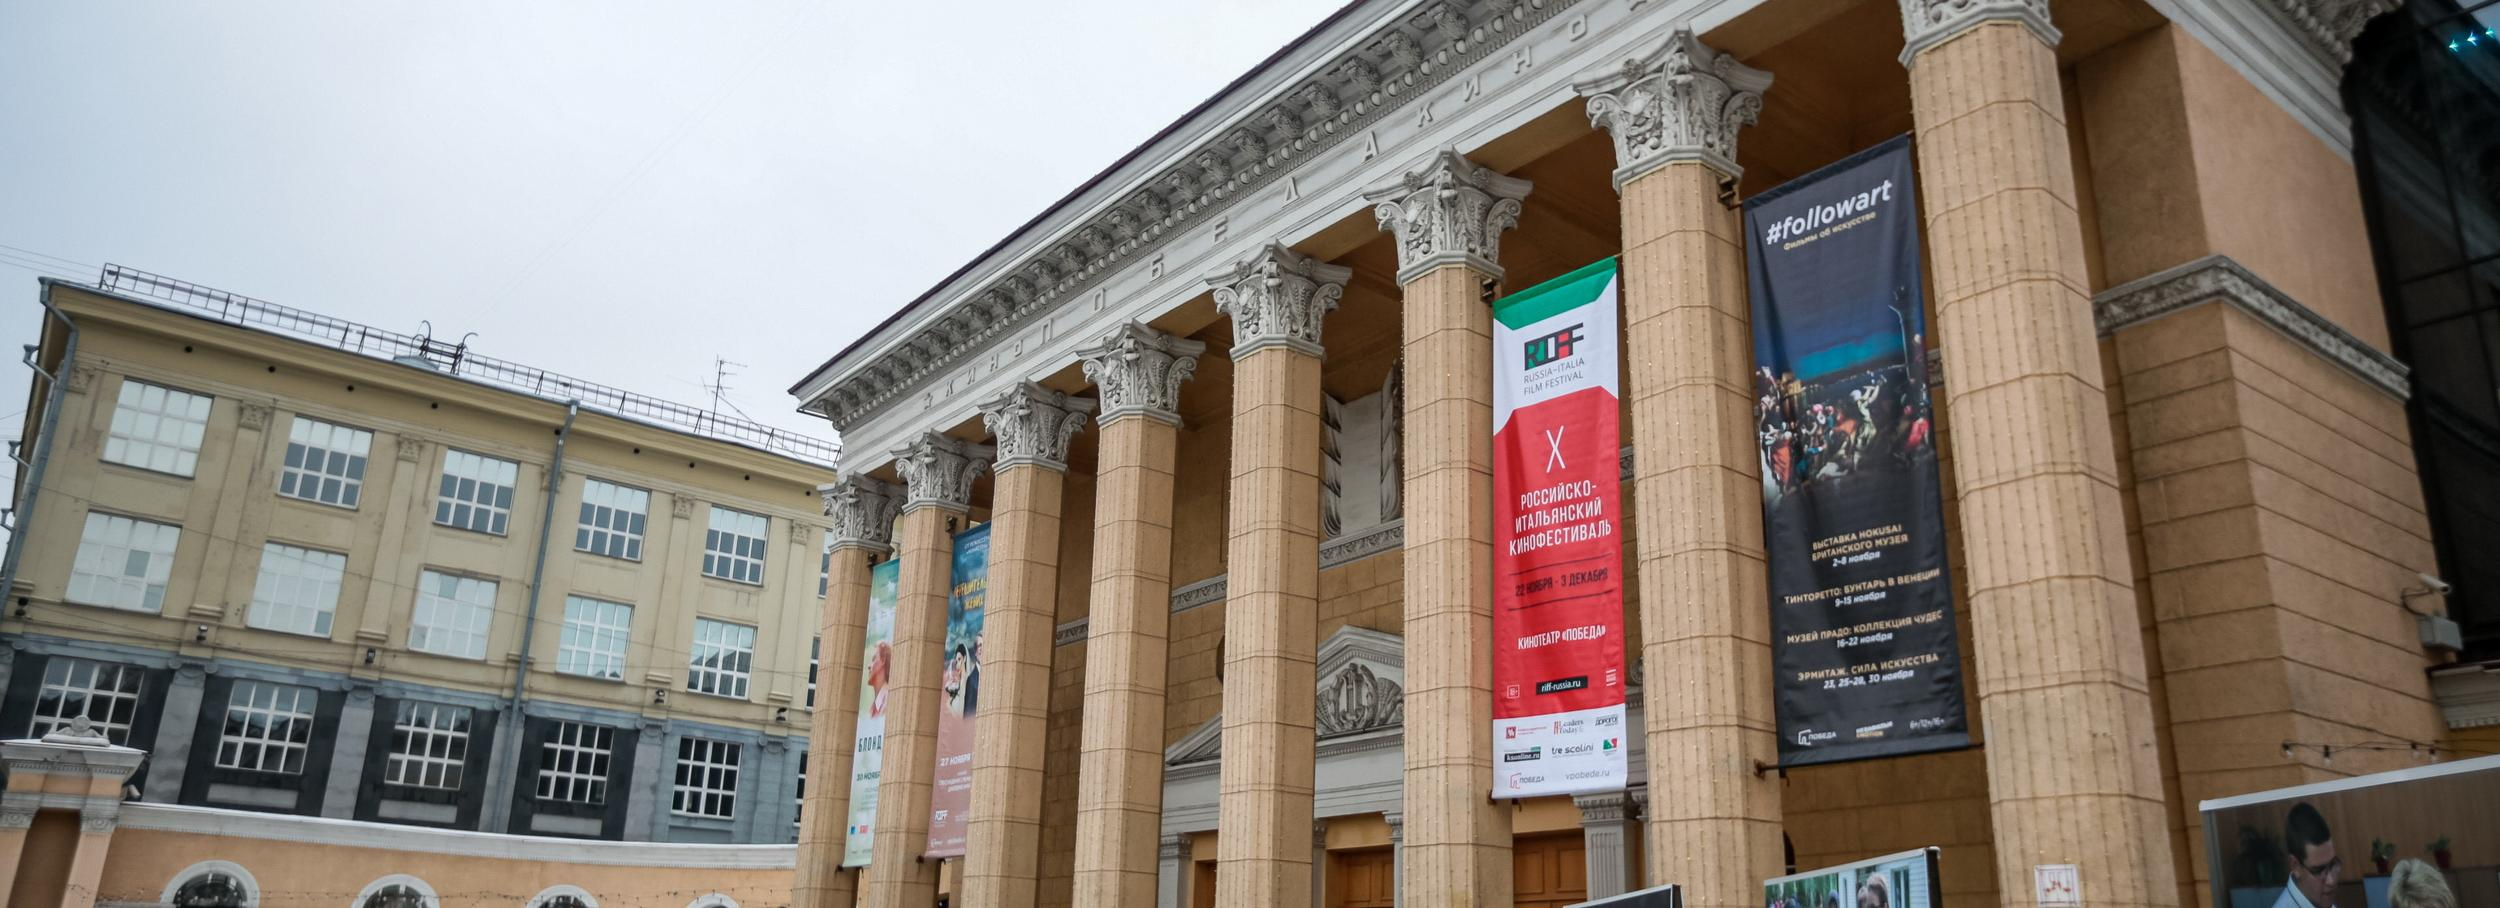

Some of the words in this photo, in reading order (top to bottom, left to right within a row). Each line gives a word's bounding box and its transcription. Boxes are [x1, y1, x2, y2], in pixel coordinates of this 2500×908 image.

[1040, 131, 1379, 346] ПОБЕДА
[1417, 13, 1588, 128] КИНО
[1766, 180, 1892, 245] #followart
[1784, 233, 1818, 250] Фильмы
[1819, 227, 1830, 238] об
[1524, 357, 1584, 384] RUSSIA-ITALIA
[1524, 382, 1542, 396] FILM
[1546, 372, 1584, 390] FESTIVAL
[1546, 425, 1566, 473] X
[1521, 480, 1596, 510] РОССИЙСКО-
[1515, 496, 1602, 534] ИТАЛЬЯНСКИЙ
[1509, 518, 1612, 557] КИНОФЕСТИВАЛЬ
[1812, 532, 1857, 551] ВЫСТАВКА
[1859, 523, 1902, 539] HOKUSAI
[1812, 541, 1873, 562] БРИТАНСКОГО
[1875, 533, 1909, 548] МУЗЕЯ
[1848, 550, 1881, 564] ноября
[1516, 584, 1526, 597] 22
[1526, 577, 1553, 594] НОЯБРЯ
[1561, 575, 1567, 586] 3
[1569, 568, 1608, 586] ДЕКАБРЯ
[1784, 586, 1842, 604] ТИНТОРЕТТО:
[1844, 579, 1886, 594] БУНТАРЬ
[1888, 577, 1895, 586] В
[1897, 568, 1941, 584] ВЕНЕЦИИ
[1852, 591, 1886, 604] ноября
[1518, 630, 1560, 650] КИНОТЕАТР
[1562, 625, 1606, 642] «ПОБЕДА»
[1786, 631, 1819, 644] МУЗЕЙ
[1820, 626, 1852, 640] ПРАДО:
[1853, 617, 1912, 634] КОЛЛЕКЦИЯ
[1914, 609, 1943, 624] ЧУДЕС
[1860, 632, 1893, 646] ноября
[1798, 668, 1848, 681] ЭРМИТАЖ.
[1851, 662, 1878, 674] СИЛА
[1880, 653, 1939, 670] ИСКУССТВА
[1824, 679, 1836, 690] 23,
[1868, 674, 1880, 684] 30
[1882, 669, 1914, 682] ноября
[1541, 680, 1581, 693] riff-russia.ru
[1808, 731, 1837, 740] ПОБЕДА
